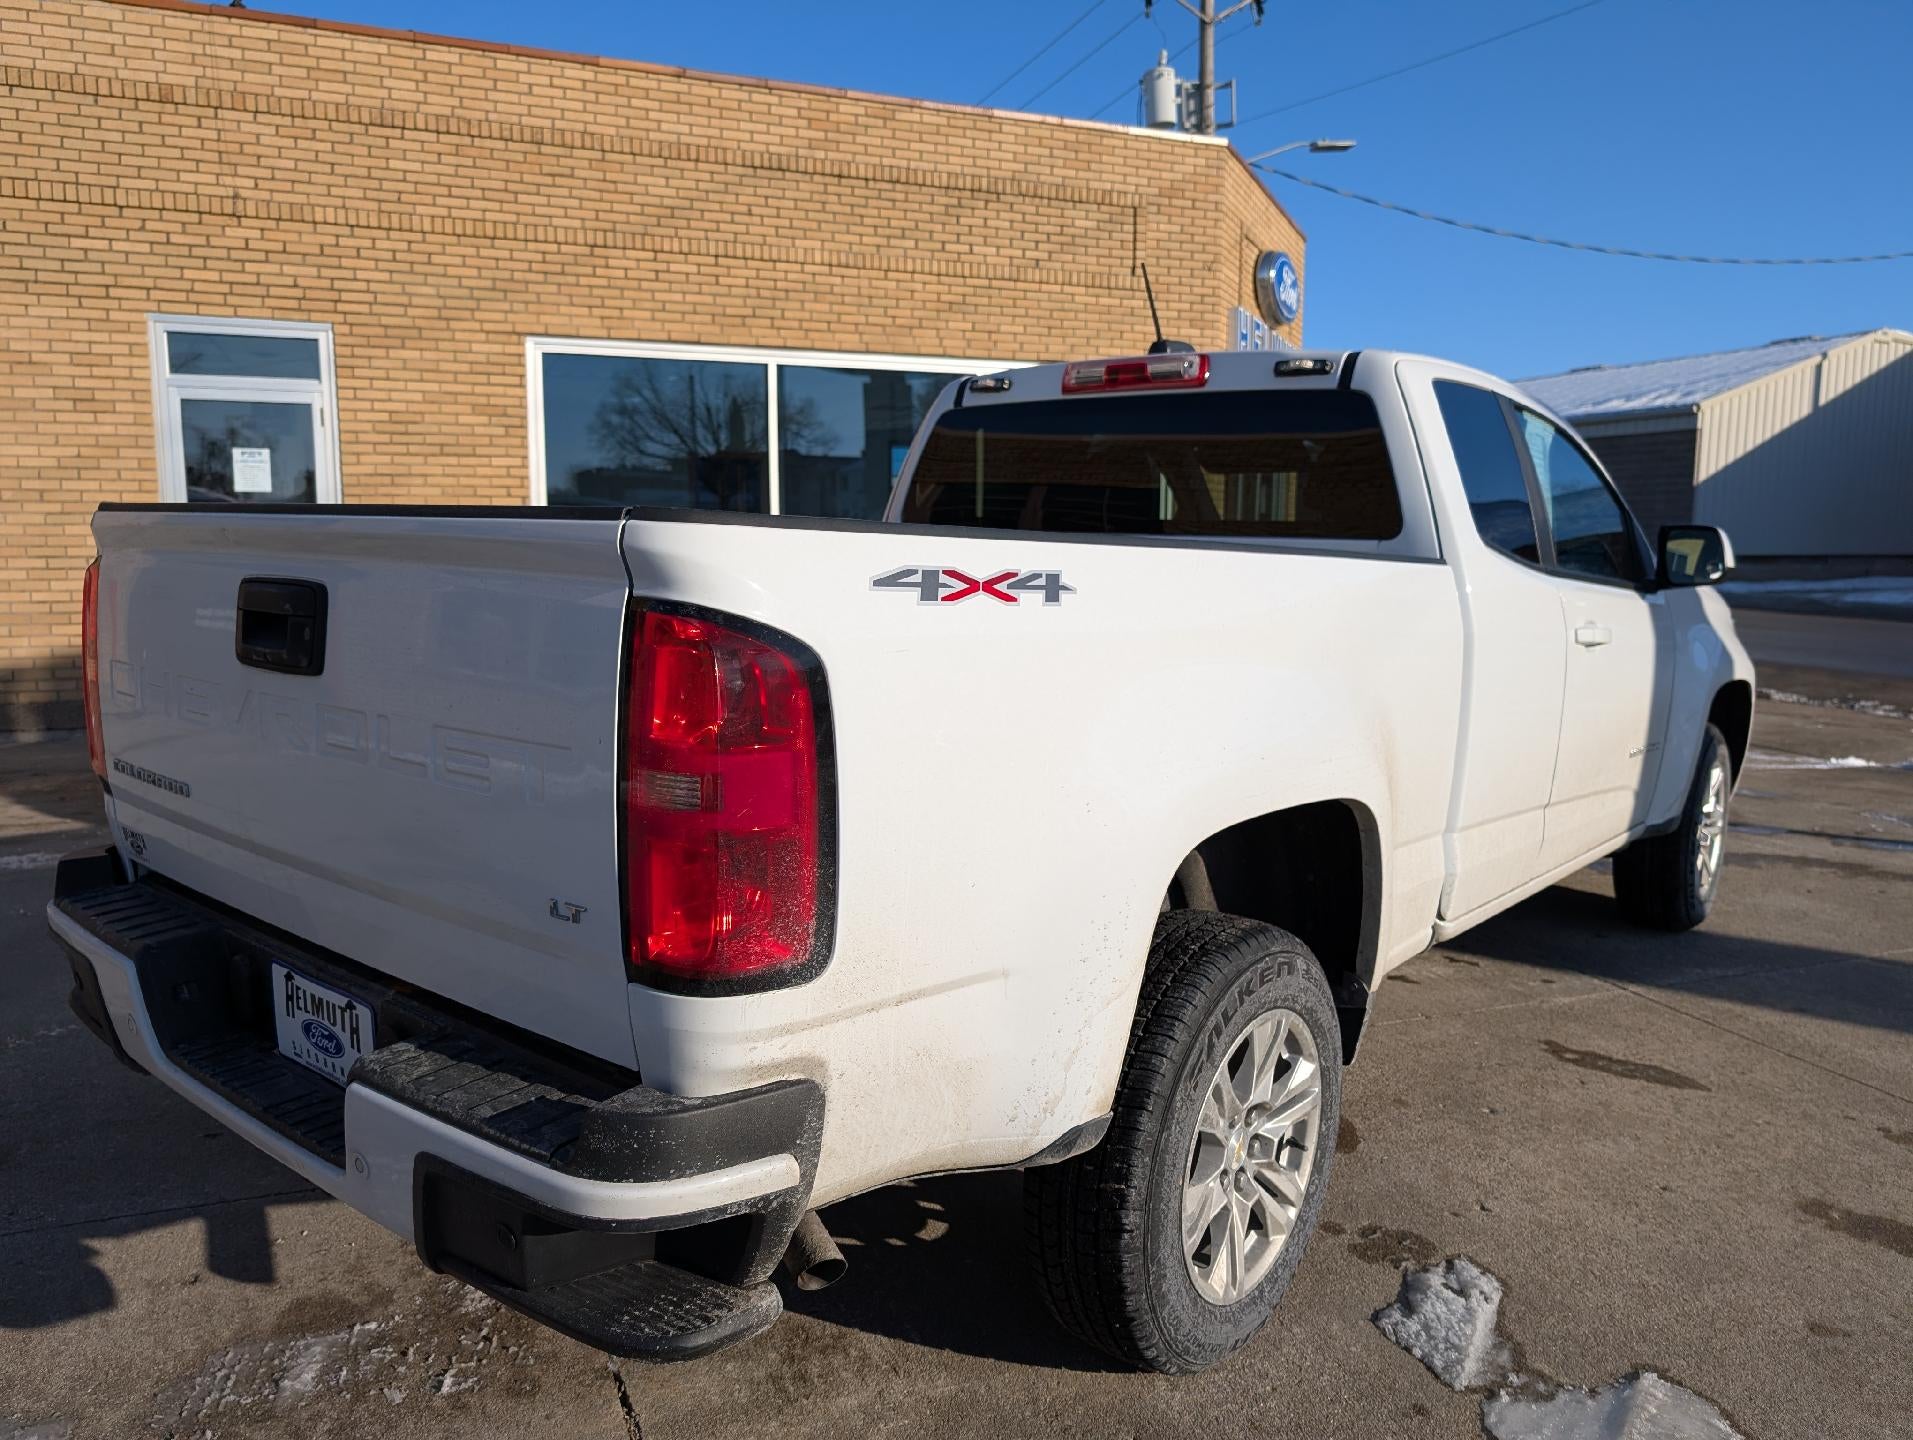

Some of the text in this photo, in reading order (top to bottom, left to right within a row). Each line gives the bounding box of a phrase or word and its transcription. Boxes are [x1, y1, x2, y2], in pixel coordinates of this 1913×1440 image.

[549, 898, 588, 924] LT
[284, 970, 362, 1054] HELMUTH
[309, 1023, 338, 1055] Ford
